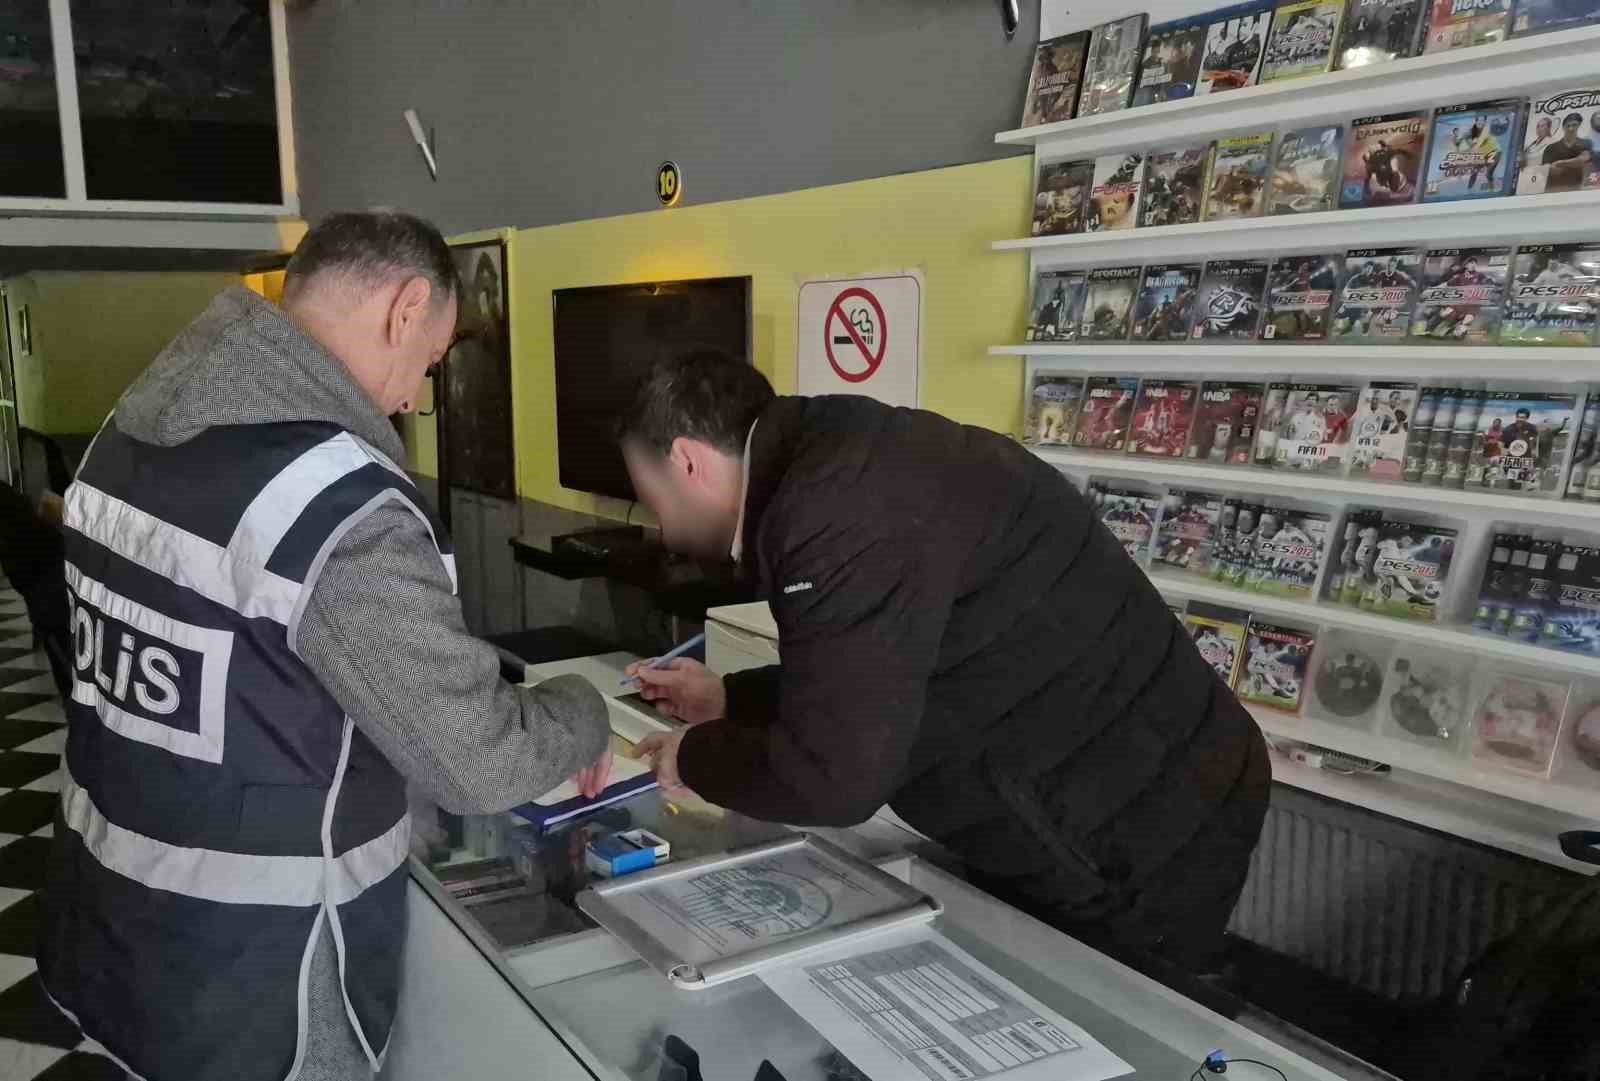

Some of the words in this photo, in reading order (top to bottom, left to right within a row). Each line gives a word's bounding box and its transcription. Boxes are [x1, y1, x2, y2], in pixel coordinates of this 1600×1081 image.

[1093, 182, 1139, 196] PURE
[1432, 290, 1463, 300] PES
[1520, 286, 1559, 296] PES
[1349, 292, 1379, 301] PES
[1206, 391, 1231, 402] NBA
[1297, 446, 1317, 456] FIFA
[1319, 447, 1327, 456] 11
[1262, 543, 1290, 553] PES
[1383, 560, 1412, 571] PES
